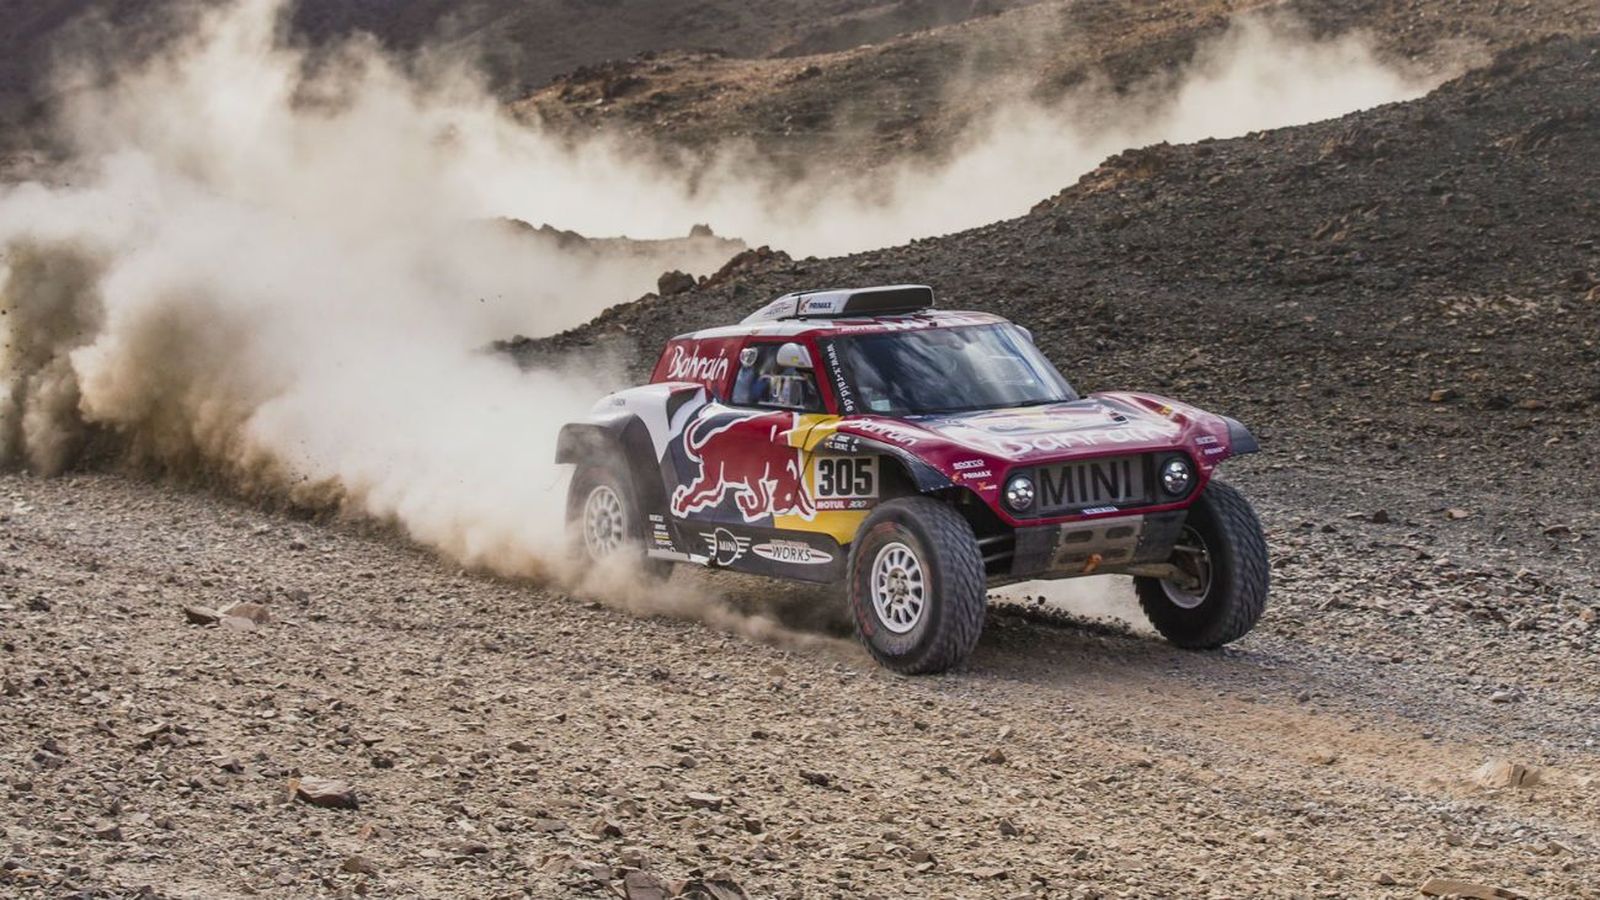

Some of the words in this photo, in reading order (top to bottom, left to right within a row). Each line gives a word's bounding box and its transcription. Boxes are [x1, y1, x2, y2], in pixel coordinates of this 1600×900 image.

[667, 345, 729, 381] Bahrain
[826, 343, 855, 412] www.x-raid.de
[818, 458, 873, 496] 305
[963, 469, 992, 479] PRIMAX
[1039, 460, 1132, 507] MINI
[816, 500, 846, 509] MOTUL
[718, 541, 736, 552] MINI
[772, 545, 812, 562] WORKS
